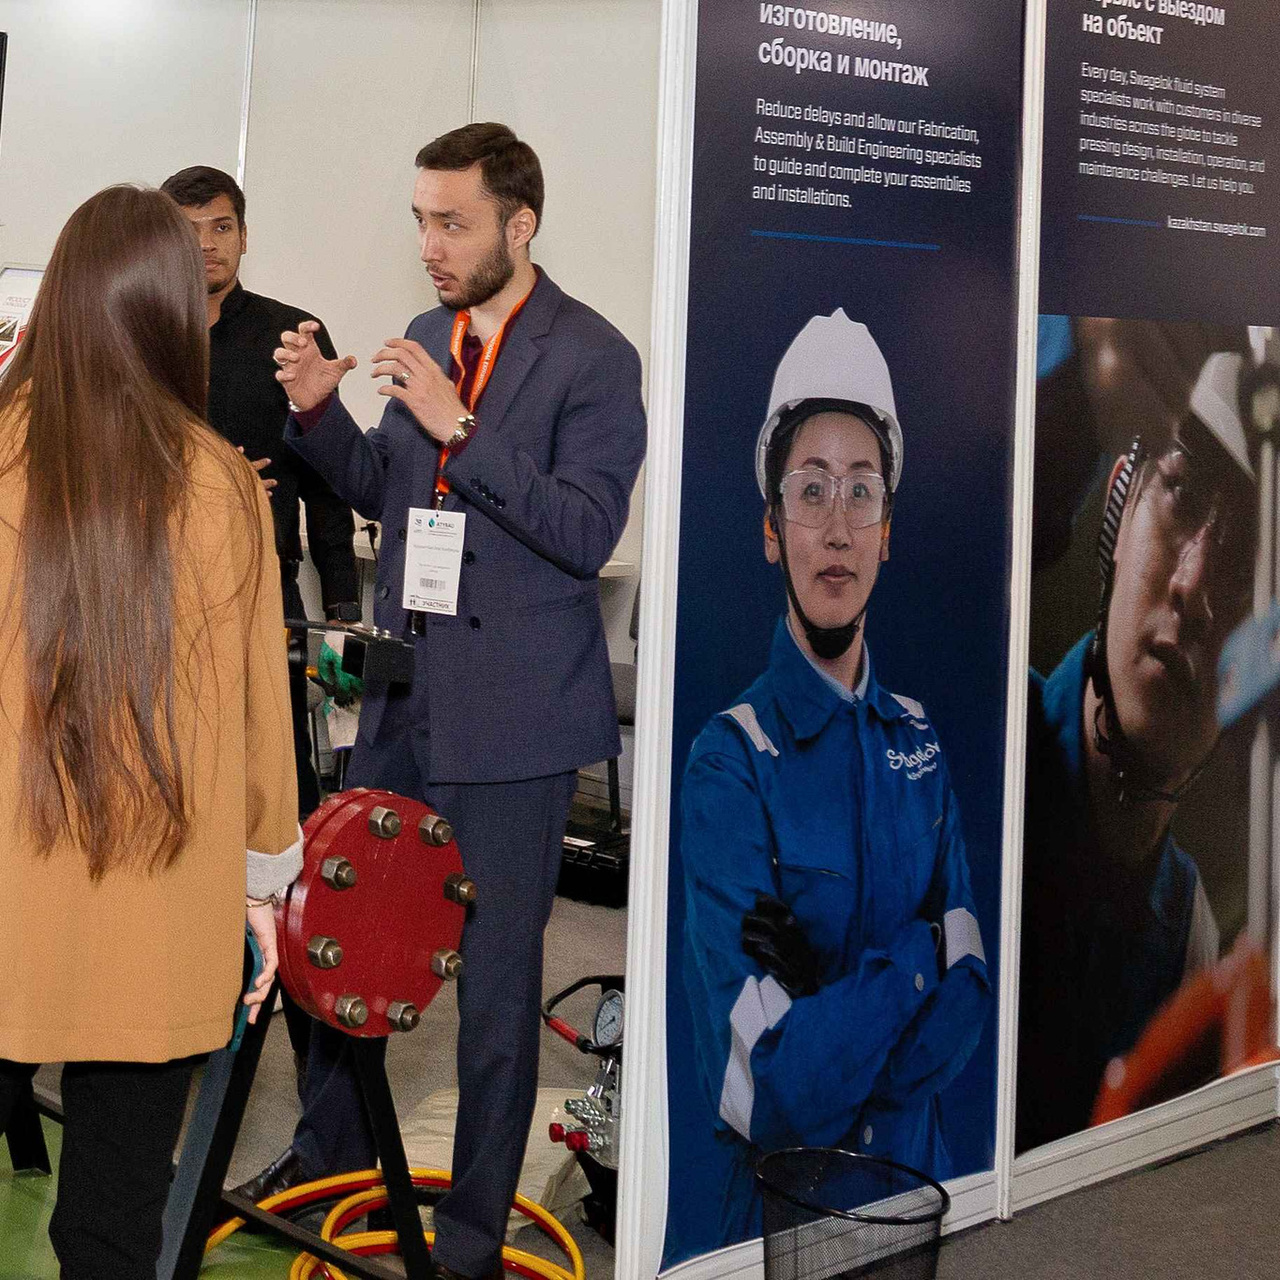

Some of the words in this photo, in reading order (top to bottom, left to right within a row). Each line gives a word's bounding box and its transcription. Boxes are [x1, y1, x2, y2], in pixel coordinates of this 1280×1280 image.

[760, 3, 902, 50] изготовление,
[1083, 13, 1103, 34] на
[1107, 14, 1164, 44] объект
[759, 38, 832, 74] сборка
[837, 54, 849, 74] и
[854, 57, 929, 86] монтаж
[1081, 62, 1110, 82] Every
[1110, 68, 1129, 85] day,
[1130, 70, 1173, 90] Swagelok
[1194, 81, 1225, 98] system
[756, 98, 802, 120] Reduce
[804, 105, 841, 126] delays
[844, 112, 865, 127] and
[867, 113, 896, 132] allow
[897, 121, 916, 134] our
[918, 119, 980, 144] Fabrication,
[1080, 89, 1131, 108] specialists
[1133, 97, 1155, 111] work
[1156, 99, 1174, 114] with
[1176, 103, 1221, 122] customers
[1222, 108, 1231, 123] in
[1231, 109, 1262, 127] diverse
[754, 126, 814, 151] Assembly
[816, 133, 825, 150] &
[827, 135, 855, 153] Build
[858, 138, 923, 164] Engineering
[925, 149, 982, 168] specialists
[1080, 111, 1128, 131] industries
[1128, 120, 1159, 136] across
[1161, 123, 1175, 138] the
[1177, 125, 1201, 141] globe
[1202, 129, 1211, 142] to
[1212, 130, 1238, 146] tackle
[753, 155, 766, 171] to
[769, 157, 802, 175] guide
[804, 161, 826, 177] and
[829, 165, 882, 184] complete
[883, 172, 909, 187] your
[910, 174, 971, 193] assemblies
[1079, 138, 1120, 156] pressing
[1122, 141, 1155, 160] design,
[1156, 145, 1206, 166] installation,
[1207, 155, 1248, 173] operation,
[1249, 159, 1265, 173] and
[753, 184, 775, 200] and
[778, 184, 852, 208] installations.
[1079, 161, 1139, 181] maintenance
[1140, 167, 1190, 187] challenges.
[1192, 174, 1206, 188] Let
[1207, 179, 1218, 190] us
[1219, 177, 1238, 195] help
